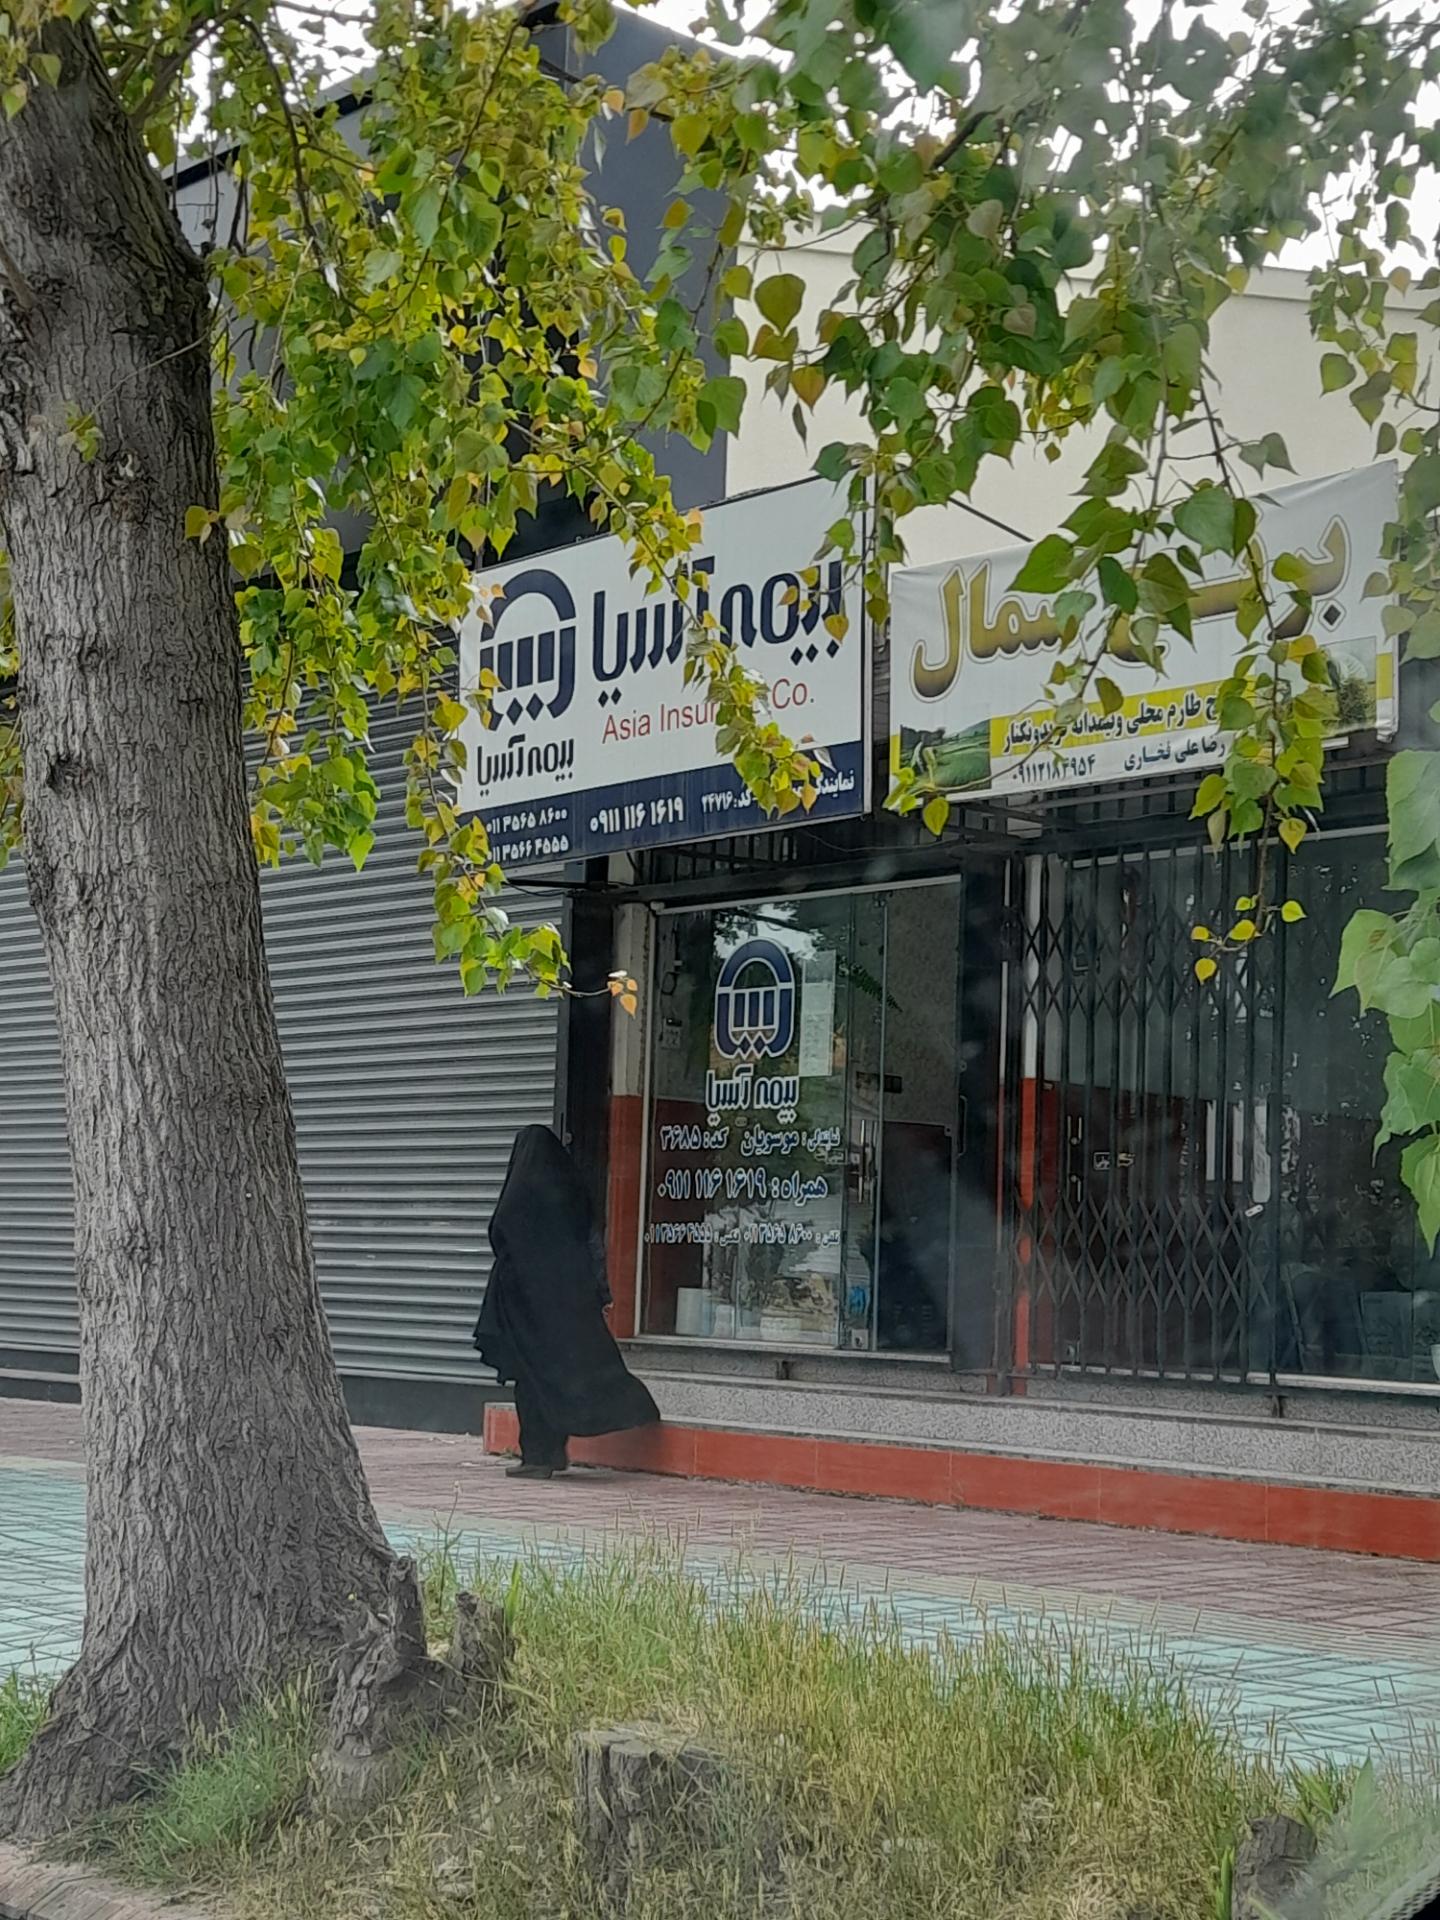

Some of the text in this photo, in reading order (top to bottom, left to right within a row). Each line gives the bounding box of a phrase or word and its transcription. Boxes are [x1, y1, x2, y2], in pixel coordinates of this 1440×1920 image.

[592, 555, 842, 707] بیمه آسیا
[602, 710, 650, 743] Asia
[772, 678, 815, 710] Co.
[477, 734, 574, 796] بیمه آسیا
[813, 770, 855, 798] نمایندگ
[590, 797, 684, 834] ۰۹۱۱ ۱۱۶ ۱۶۱۹
[706, 1065, 800, 1126] بیمه آسیا
[726, 1167, 767, 1199] ۱۶۱۹
